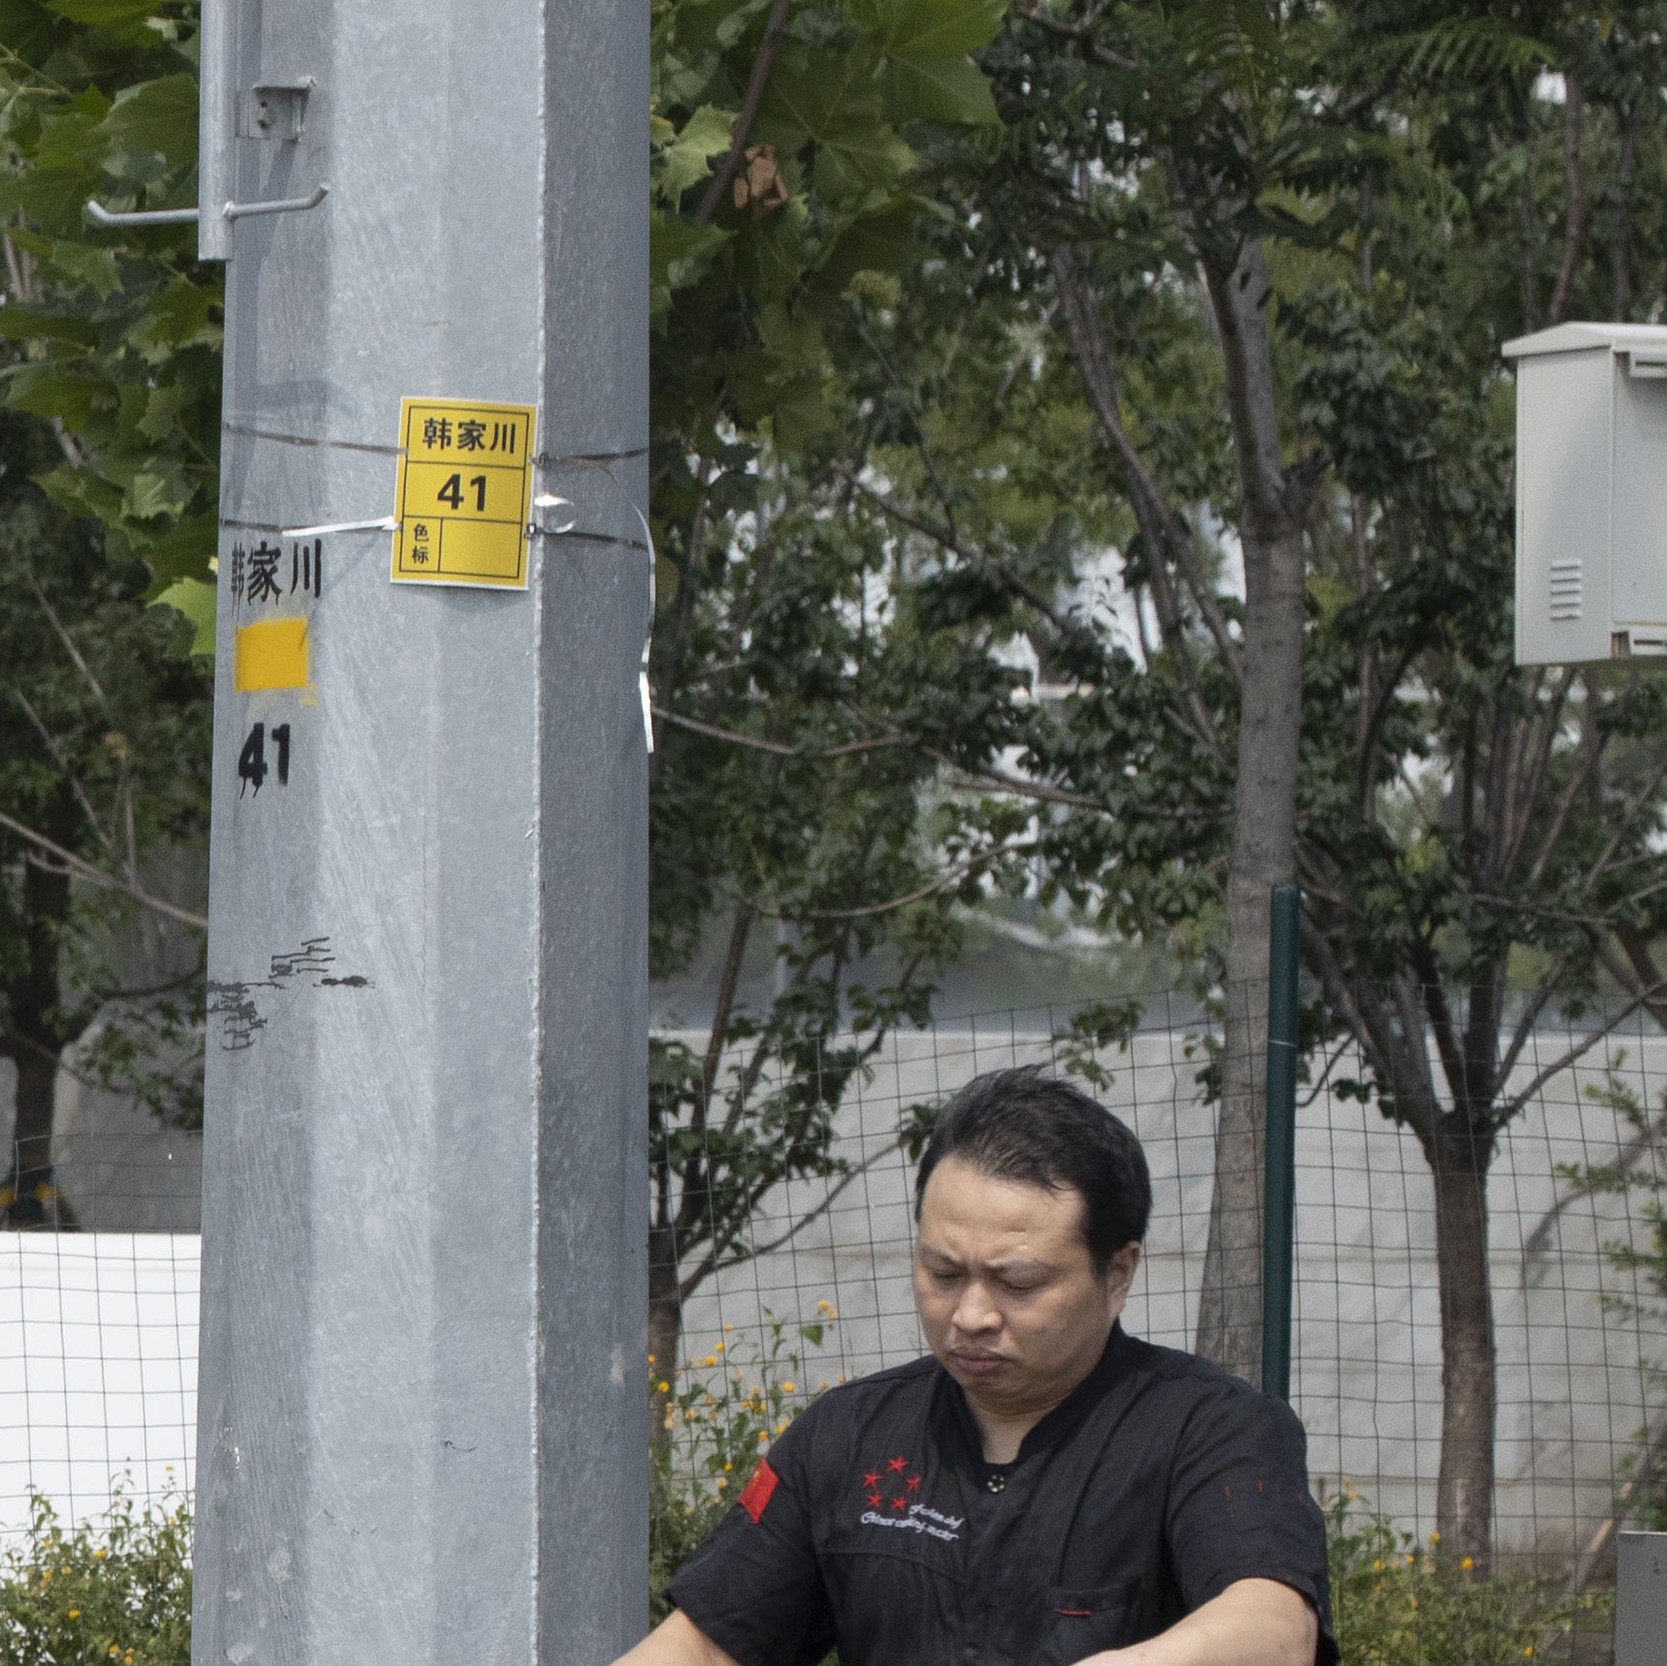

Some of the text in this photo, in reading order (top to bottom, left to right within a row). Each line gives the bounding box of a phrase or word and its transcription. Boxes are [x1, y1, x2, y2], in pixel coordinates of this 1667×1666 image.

[422, 417, 516, 454] 韩家川
[437, 473, 487, 512] 41
[412, 523, 429, 564] 色标
[238, 721, 291, 793] 41
